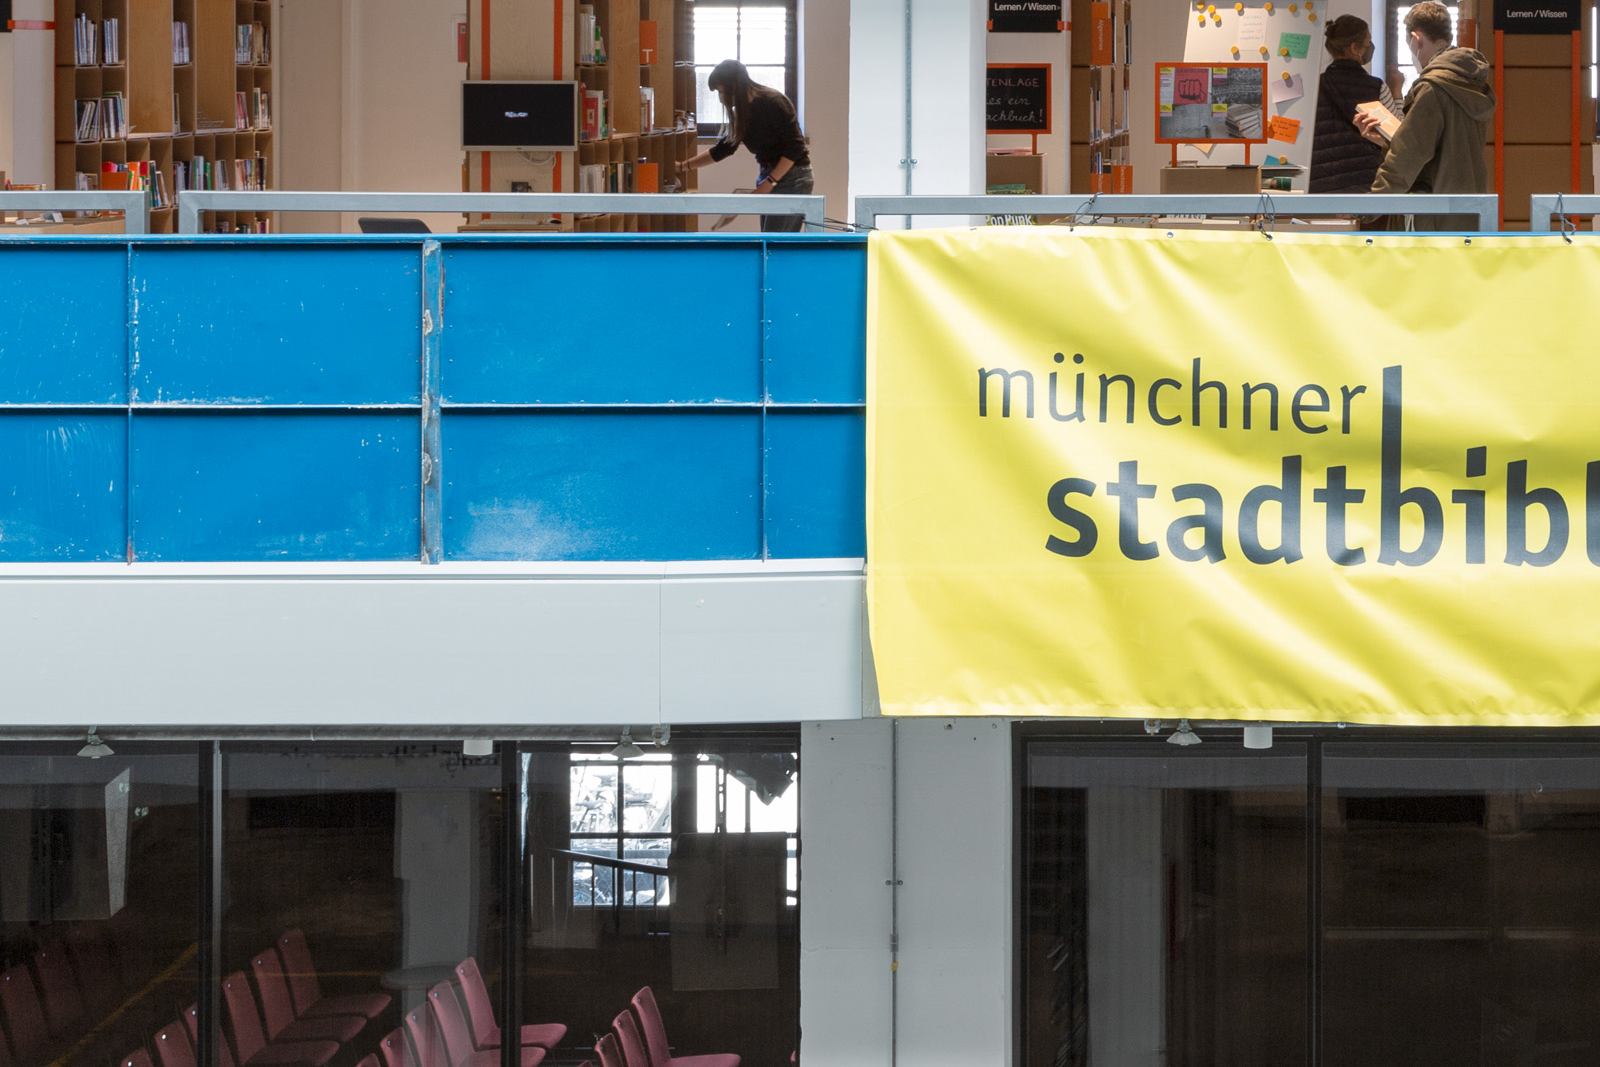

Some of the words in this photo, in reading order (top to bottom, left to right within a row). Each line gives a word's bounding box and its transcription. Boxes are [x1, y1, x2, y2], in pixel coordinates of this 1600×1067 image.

[994, 2, 1021, 11] Lernen
[1027, 2, 1057, 11] Wissen
[1506, 9, 1533, 18] Lernen
[1539, 9, 1568, 18] Wissen
[642, 49, 653, 63] T
[986, 78, 1040, 87] TENLAGE
[1005, 214, 1033, 226] Punk
[978, 353, 1366, 434] münchner
